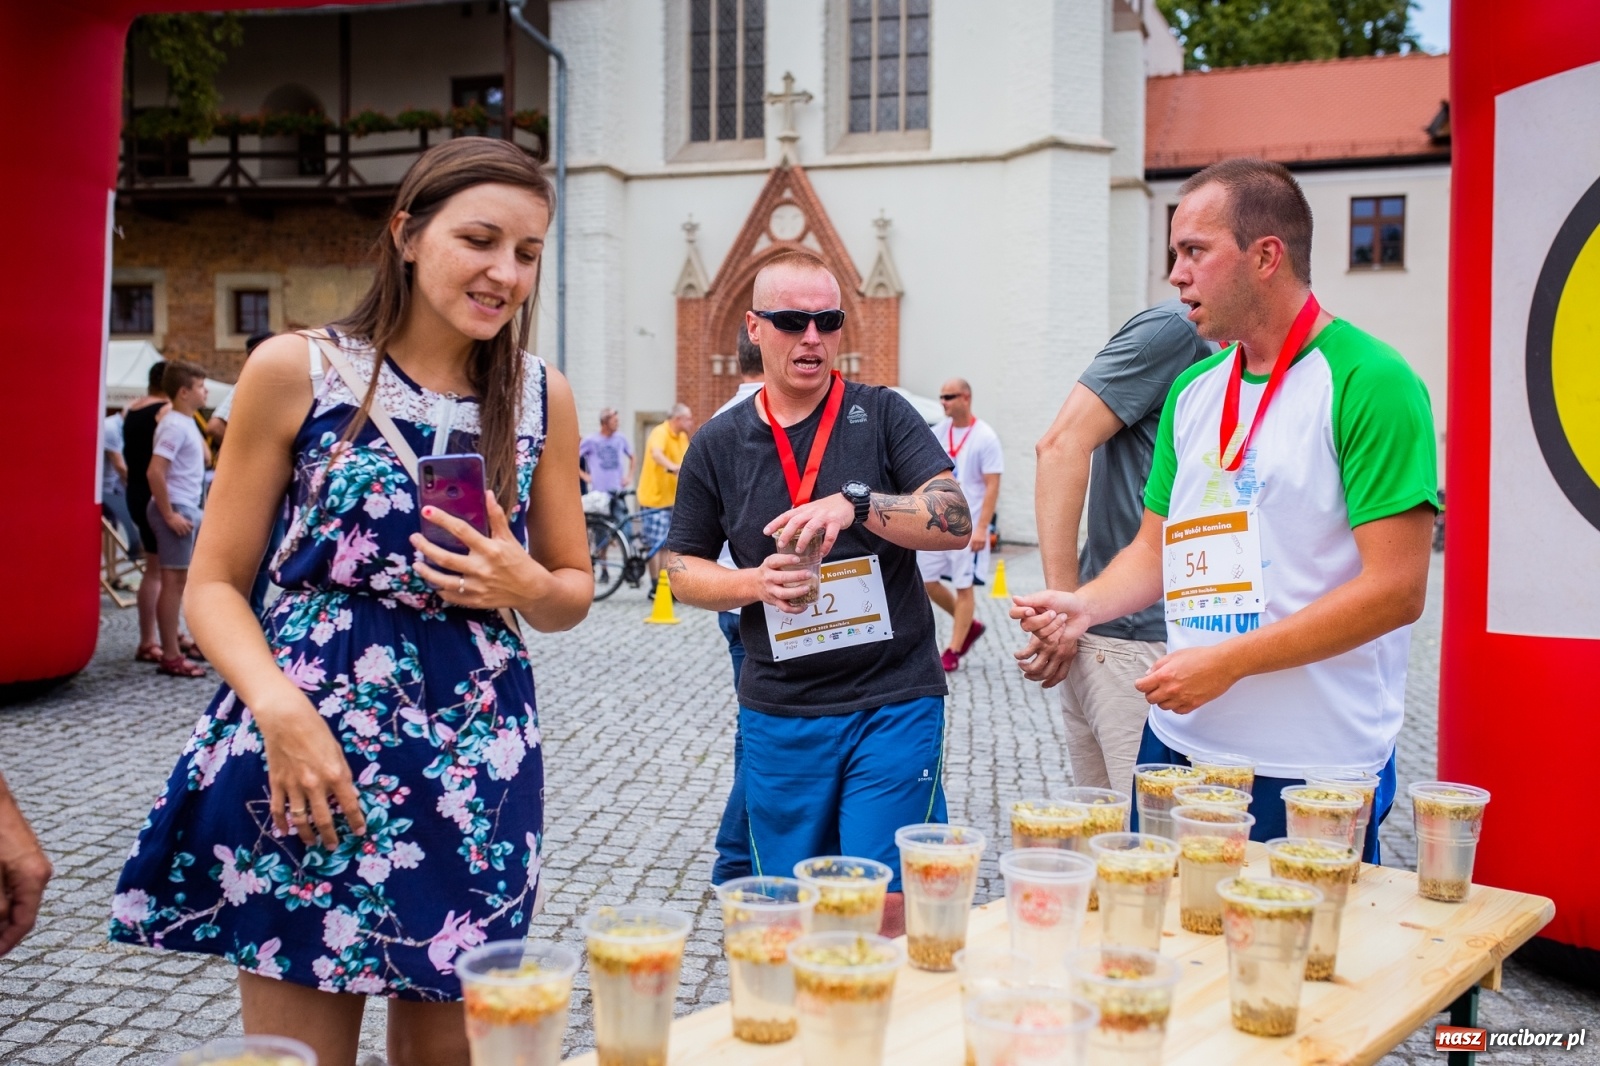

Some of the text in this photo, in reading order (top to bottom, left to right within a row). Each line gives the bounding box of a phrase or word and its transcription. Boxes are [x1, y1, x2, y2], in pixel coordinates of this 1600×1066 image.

[1202, 522, 1232, 532] Komina
[1186, 550, 1208, 577] 54
[827, 567, 858, 579] Komina
[811, 593, 838, 617] 12
